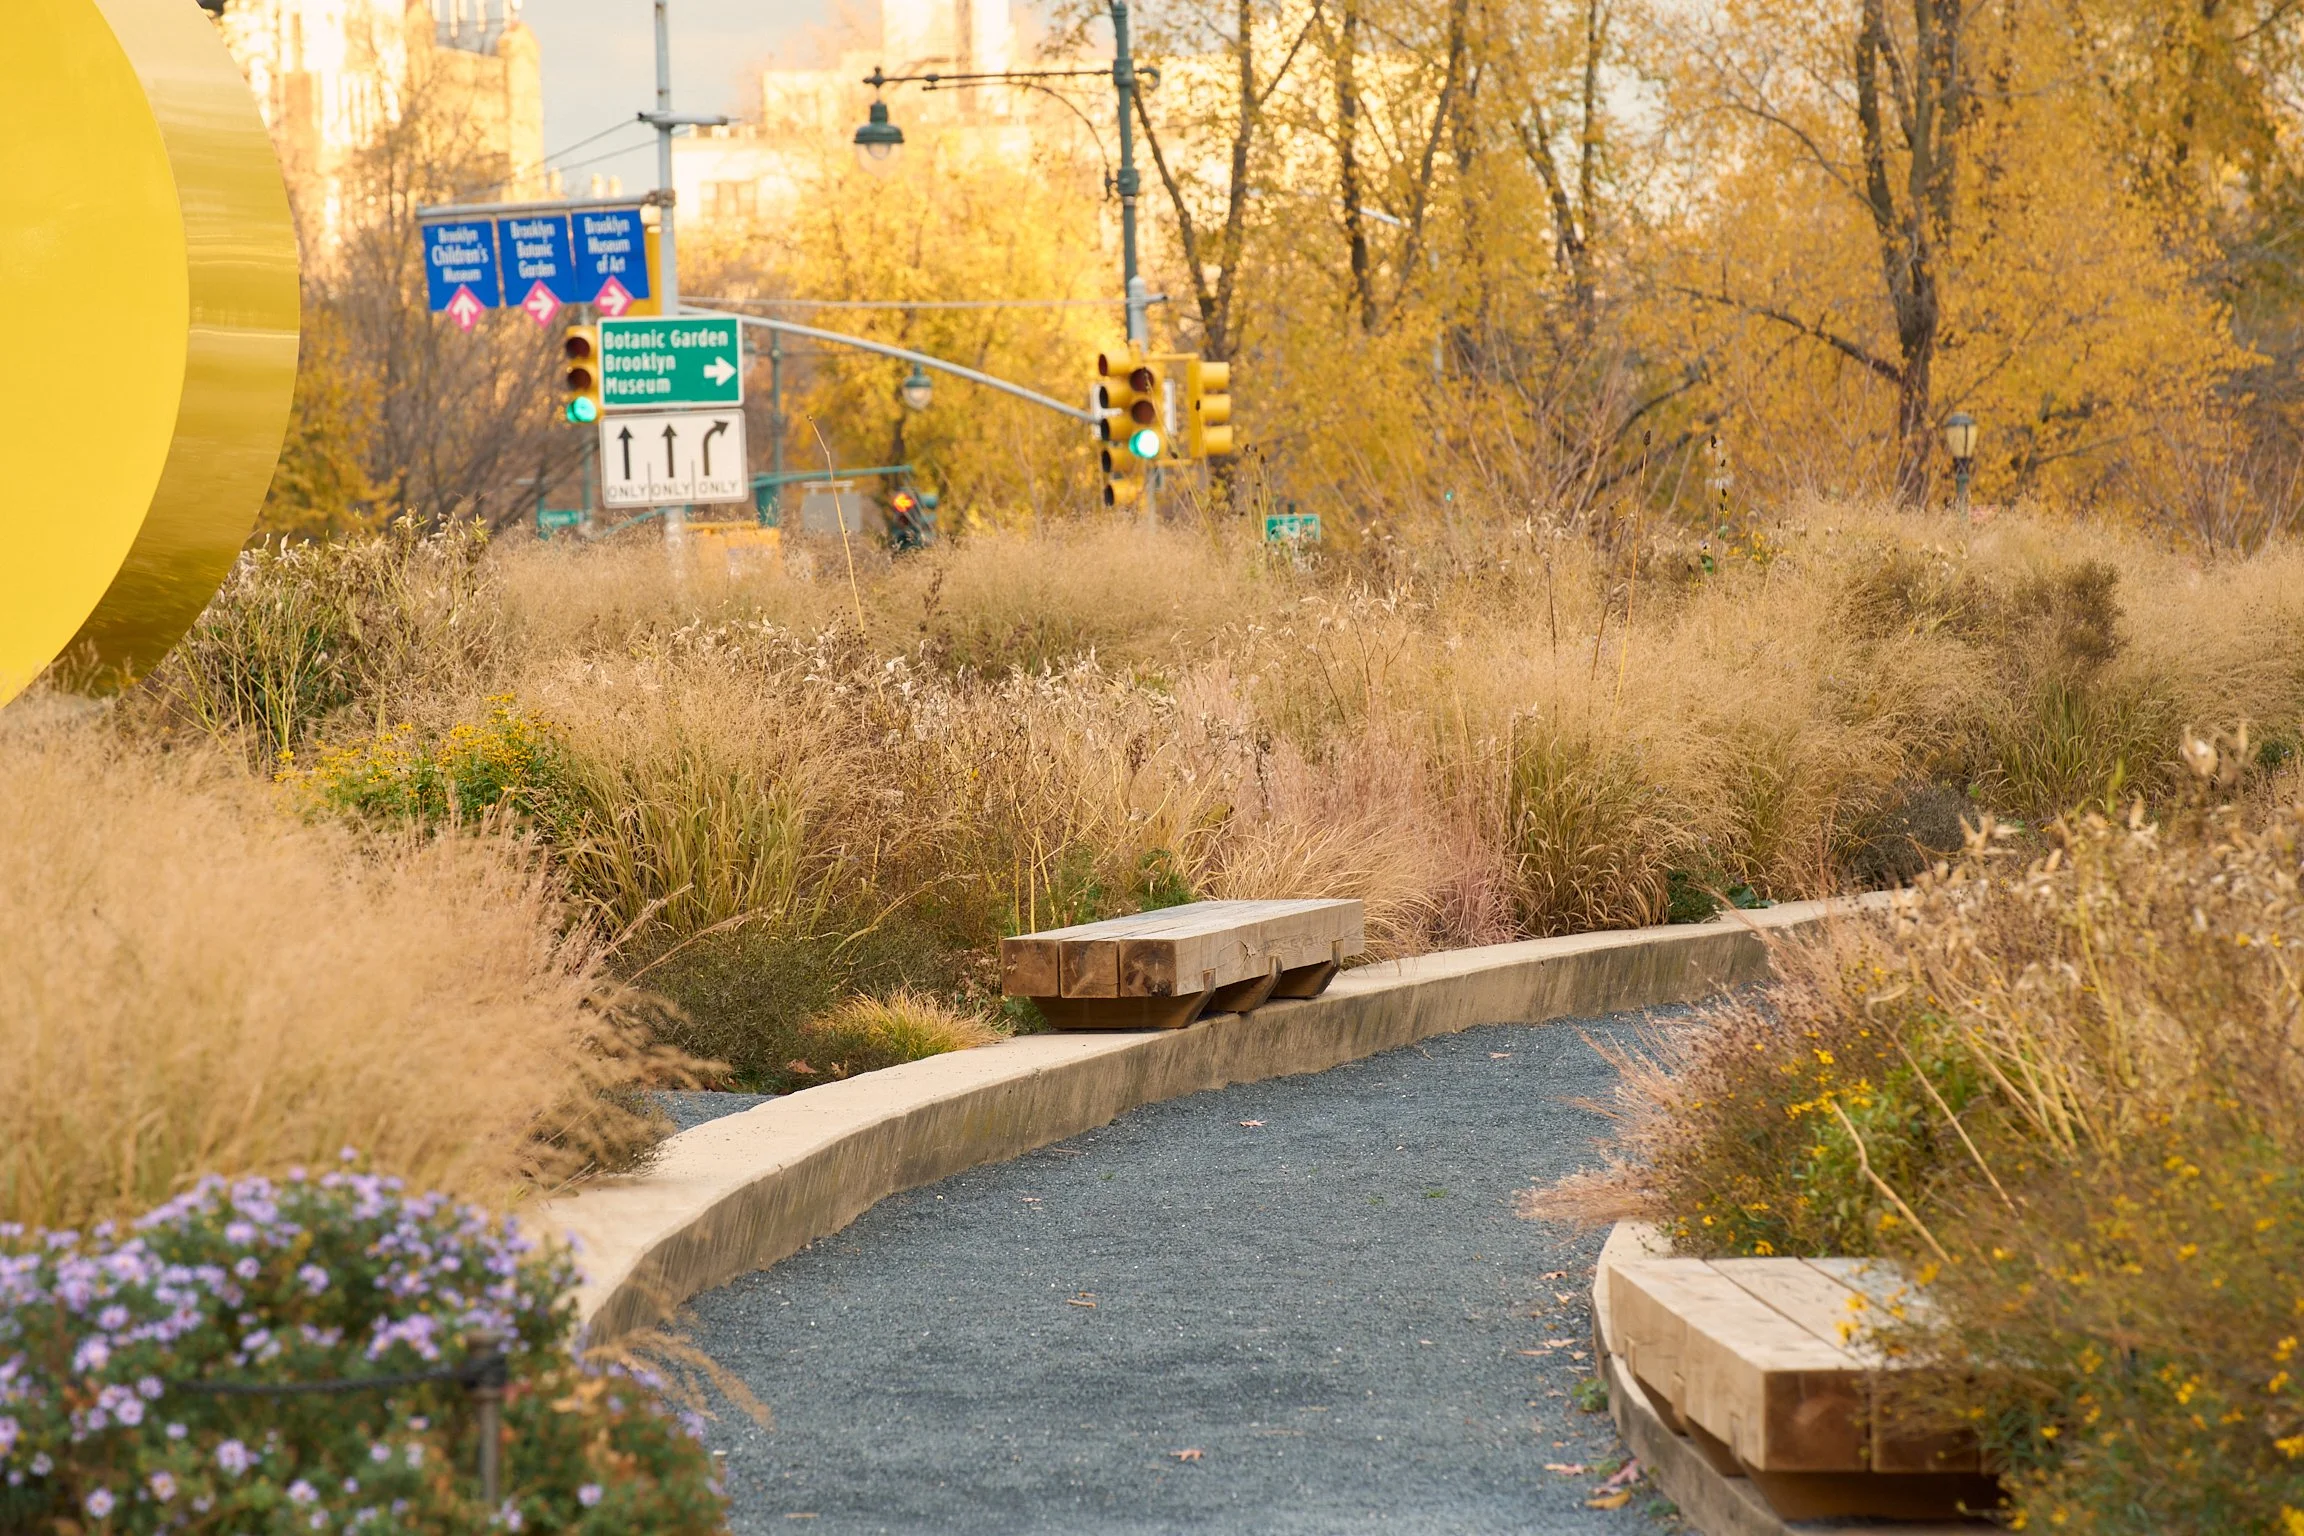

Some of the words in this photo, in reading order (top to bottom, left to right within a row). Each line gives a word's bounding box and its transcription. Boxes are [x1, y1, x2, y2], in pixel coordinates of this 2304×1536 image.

[438, 226, 479, 244] Brooklyn
[510, 220, 555, 241] Brooklyn
[583, 216, 630, 238] Brooklyn
[431, 244, 489, 266] Children's
[516, 240, 553, 259] Botanic
[588, 237, 631, 254] Museum
[518, 261, 556, 279] Garden
[596, 255, 608, 274] of
[609, 255, 626, 273] Art
[443, 267, 482, 283] Museum
[603, 329, 665, 350] Botanic
[670, 328, 729, 349] Garden
[604, 351, 677, 375] Brooklyn
[605, 376, 671, 395] Museum
[607, 483, 647, 499] ONLY
[650, 482, 691, 497] ONLY
[698, 479, 739, 494] ONLY
